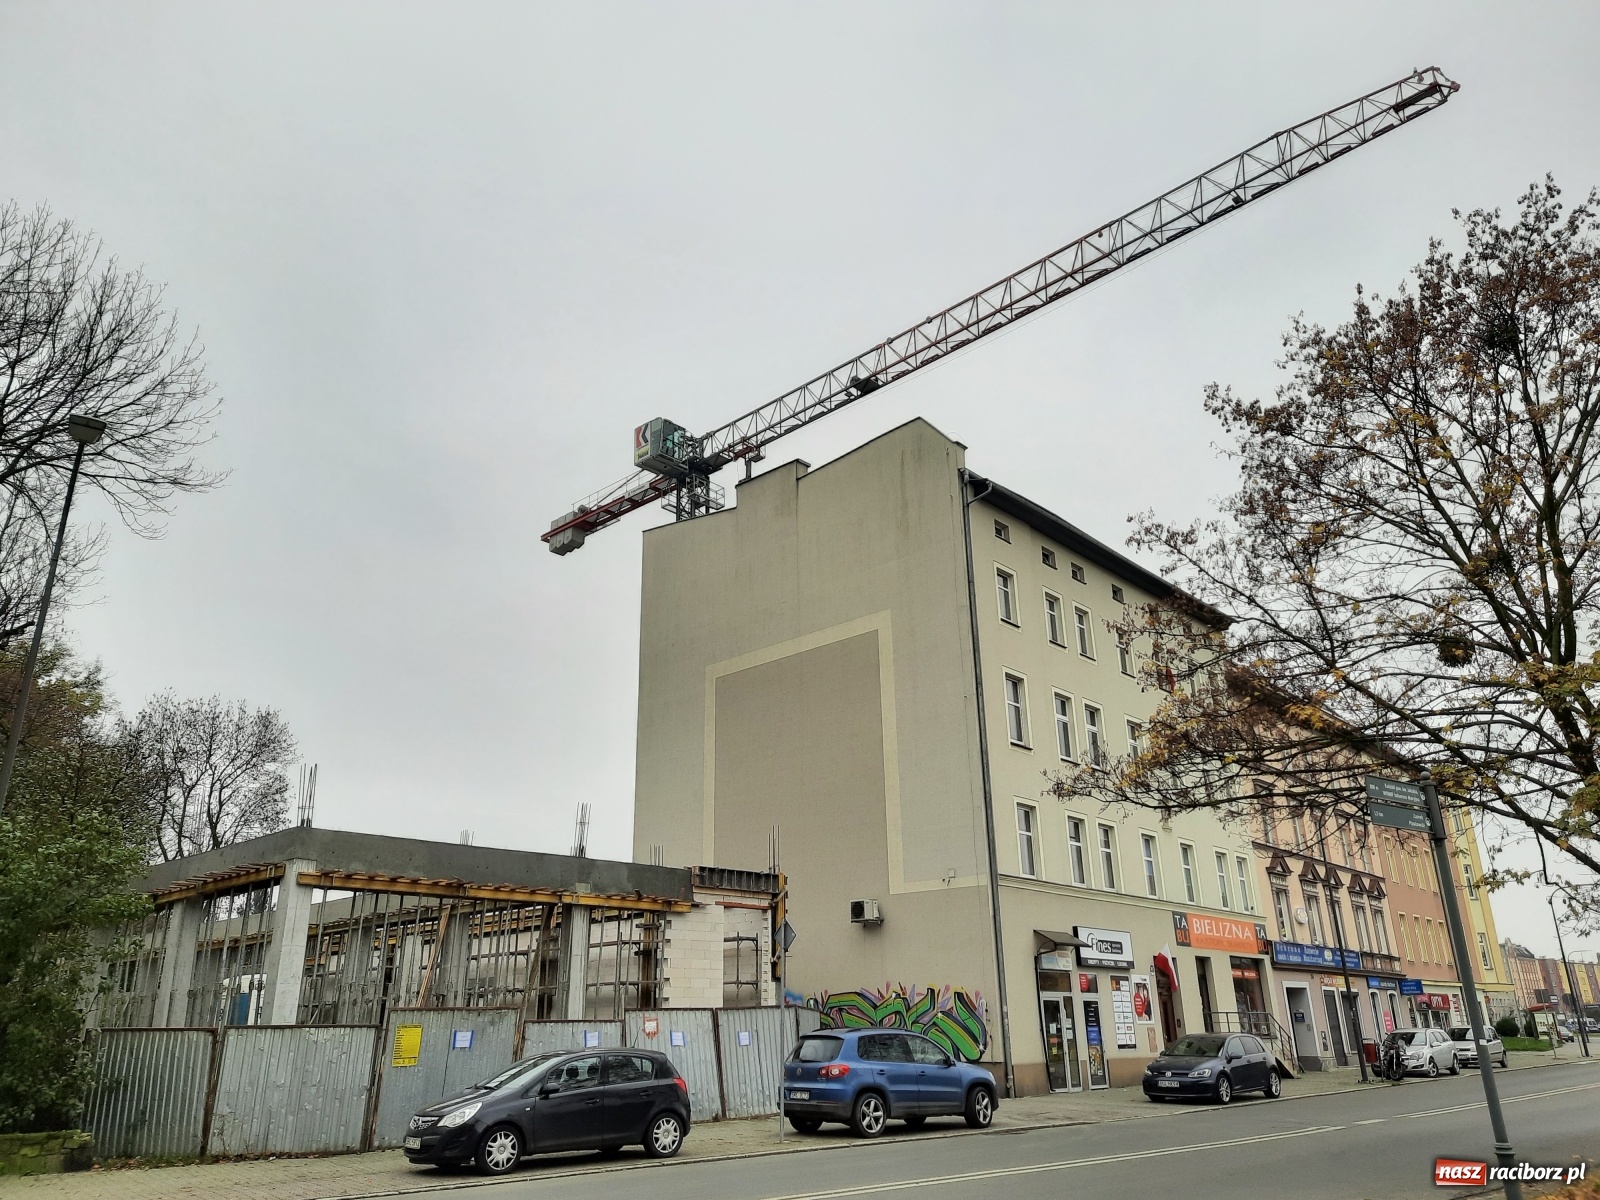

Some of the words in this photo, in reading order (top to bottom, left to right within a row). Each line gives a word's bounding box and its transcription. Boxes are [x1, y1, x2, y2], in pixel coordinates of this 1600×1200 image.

[1174, 915, 1188, 929] TA
[1192, 918, 1254, 941] BIELIZNA
[1255, 926, 1266, 939] TA
[1177, 930, 1189, 943] BU
[1091, 937, 1112, 953] Fines
[1258, 940, 1268, 951] BU
